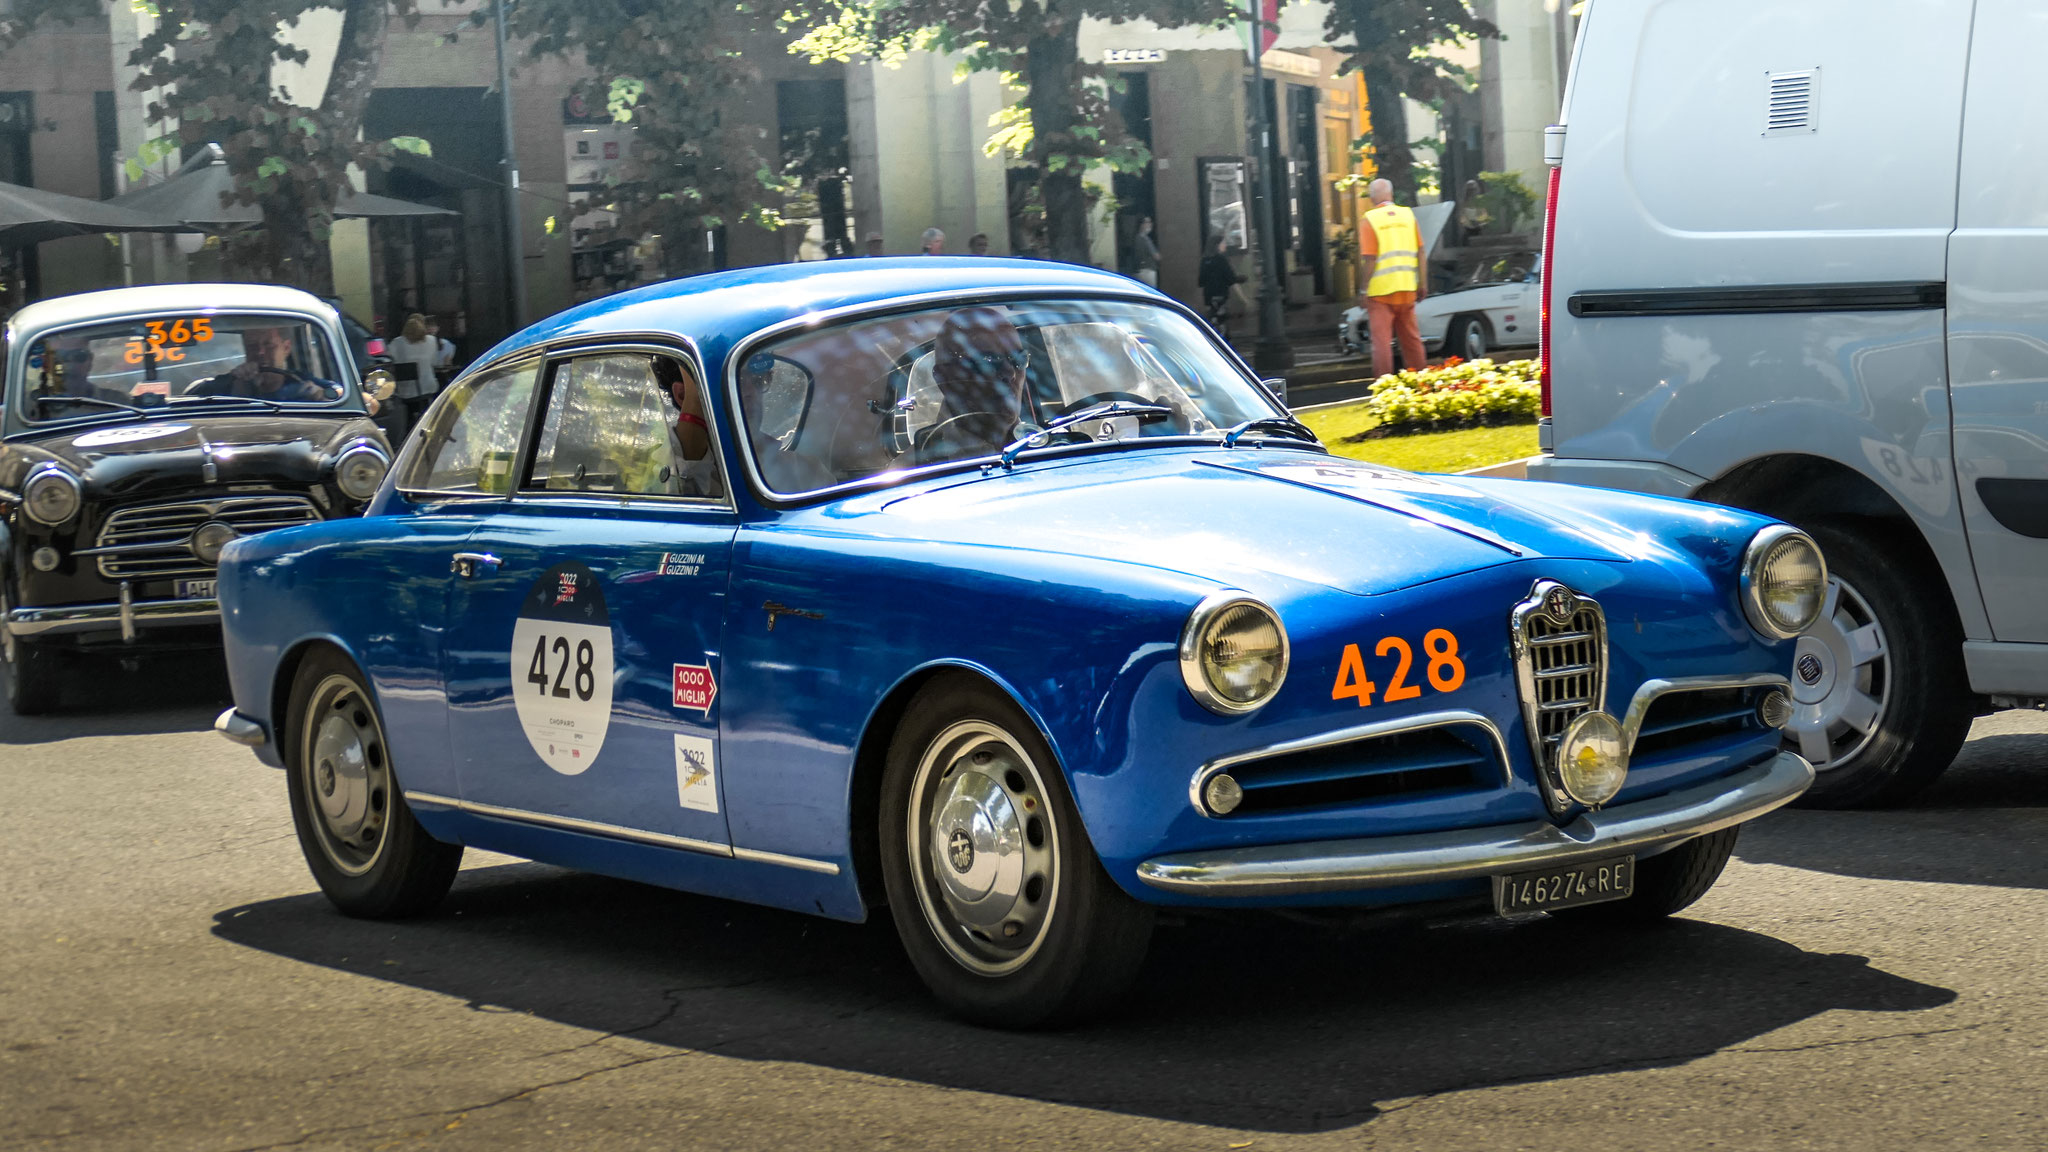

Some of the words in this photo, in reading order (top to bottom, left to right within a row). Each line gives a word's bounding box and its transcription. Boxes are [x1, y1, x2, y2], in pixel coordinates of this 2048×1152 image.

[145, 318, 214, 345] 365
[670, 553, 698, 564] GUZZINI
[666, 564, 694, 576] GUZZINI
[559, 572, 577, 585] 2022
[528, 635, 595, 702] 428
[1332, 628, 1466, 708] 428
[679, 670, 704, 686] 1000
[676, 688, 706, 704] MIGLIA
[549, 717, 575, 728] CHOPARD
[683, 748, 705, 765] 2022
[1511, 871, 1587, 907] 146274
[1598, 864, 1625, 893] RE
